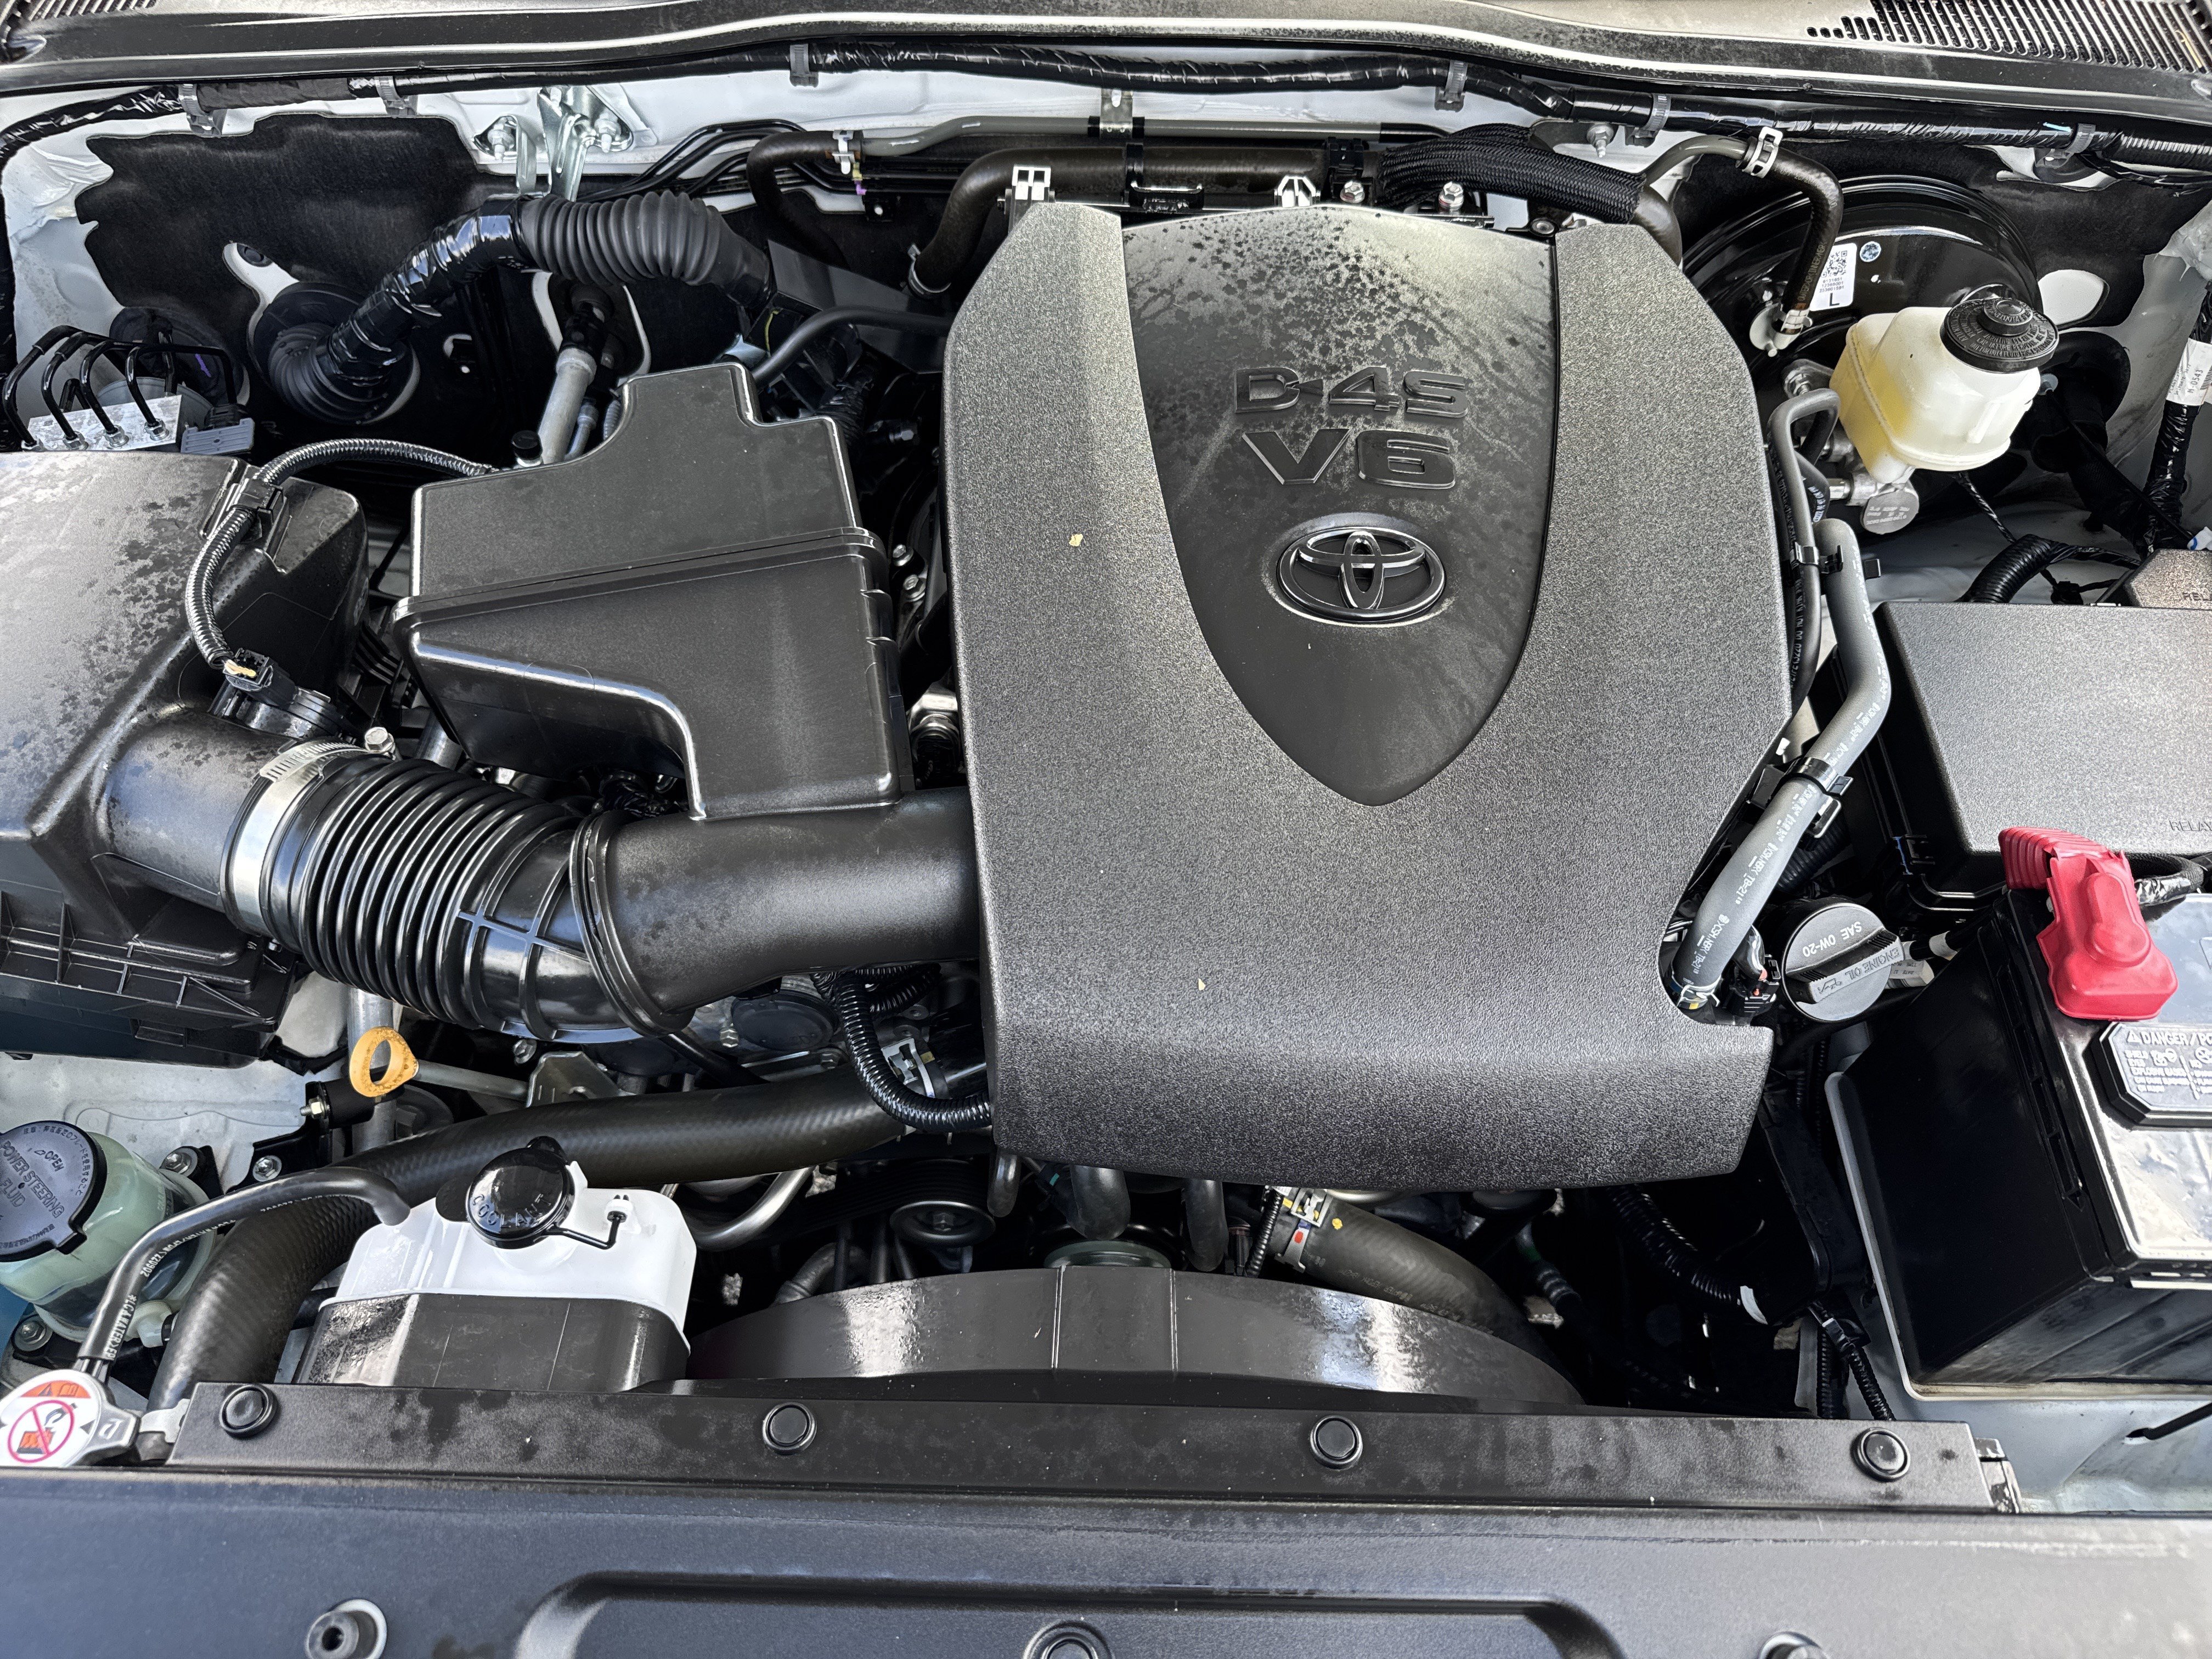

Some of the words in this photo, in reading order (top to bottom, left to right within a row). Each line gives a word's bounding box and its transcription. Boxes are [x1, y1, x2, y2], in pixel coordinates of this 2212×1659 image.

[1830, 293, 1840, 306] L
[1242, 428, 1456, 490] V6
[1839, 921, 1862, 940] SAE
[1802, 934, 1836, 957] 0W-20
[1863, 947, 1899, 973] ENGINE
[1844, 967, 1861, 980] OIL
[2140, 1031, 2189, 1046] DANGER
[44, 1150, 65, 1172] OPEN
[0, 1140, 30, 1176] POWER
[23, 1171, 65, 1218] STEERING
[1, 1177, 26, 1207] FLUID
[472, 1193, 552, 1228] COOLANT
